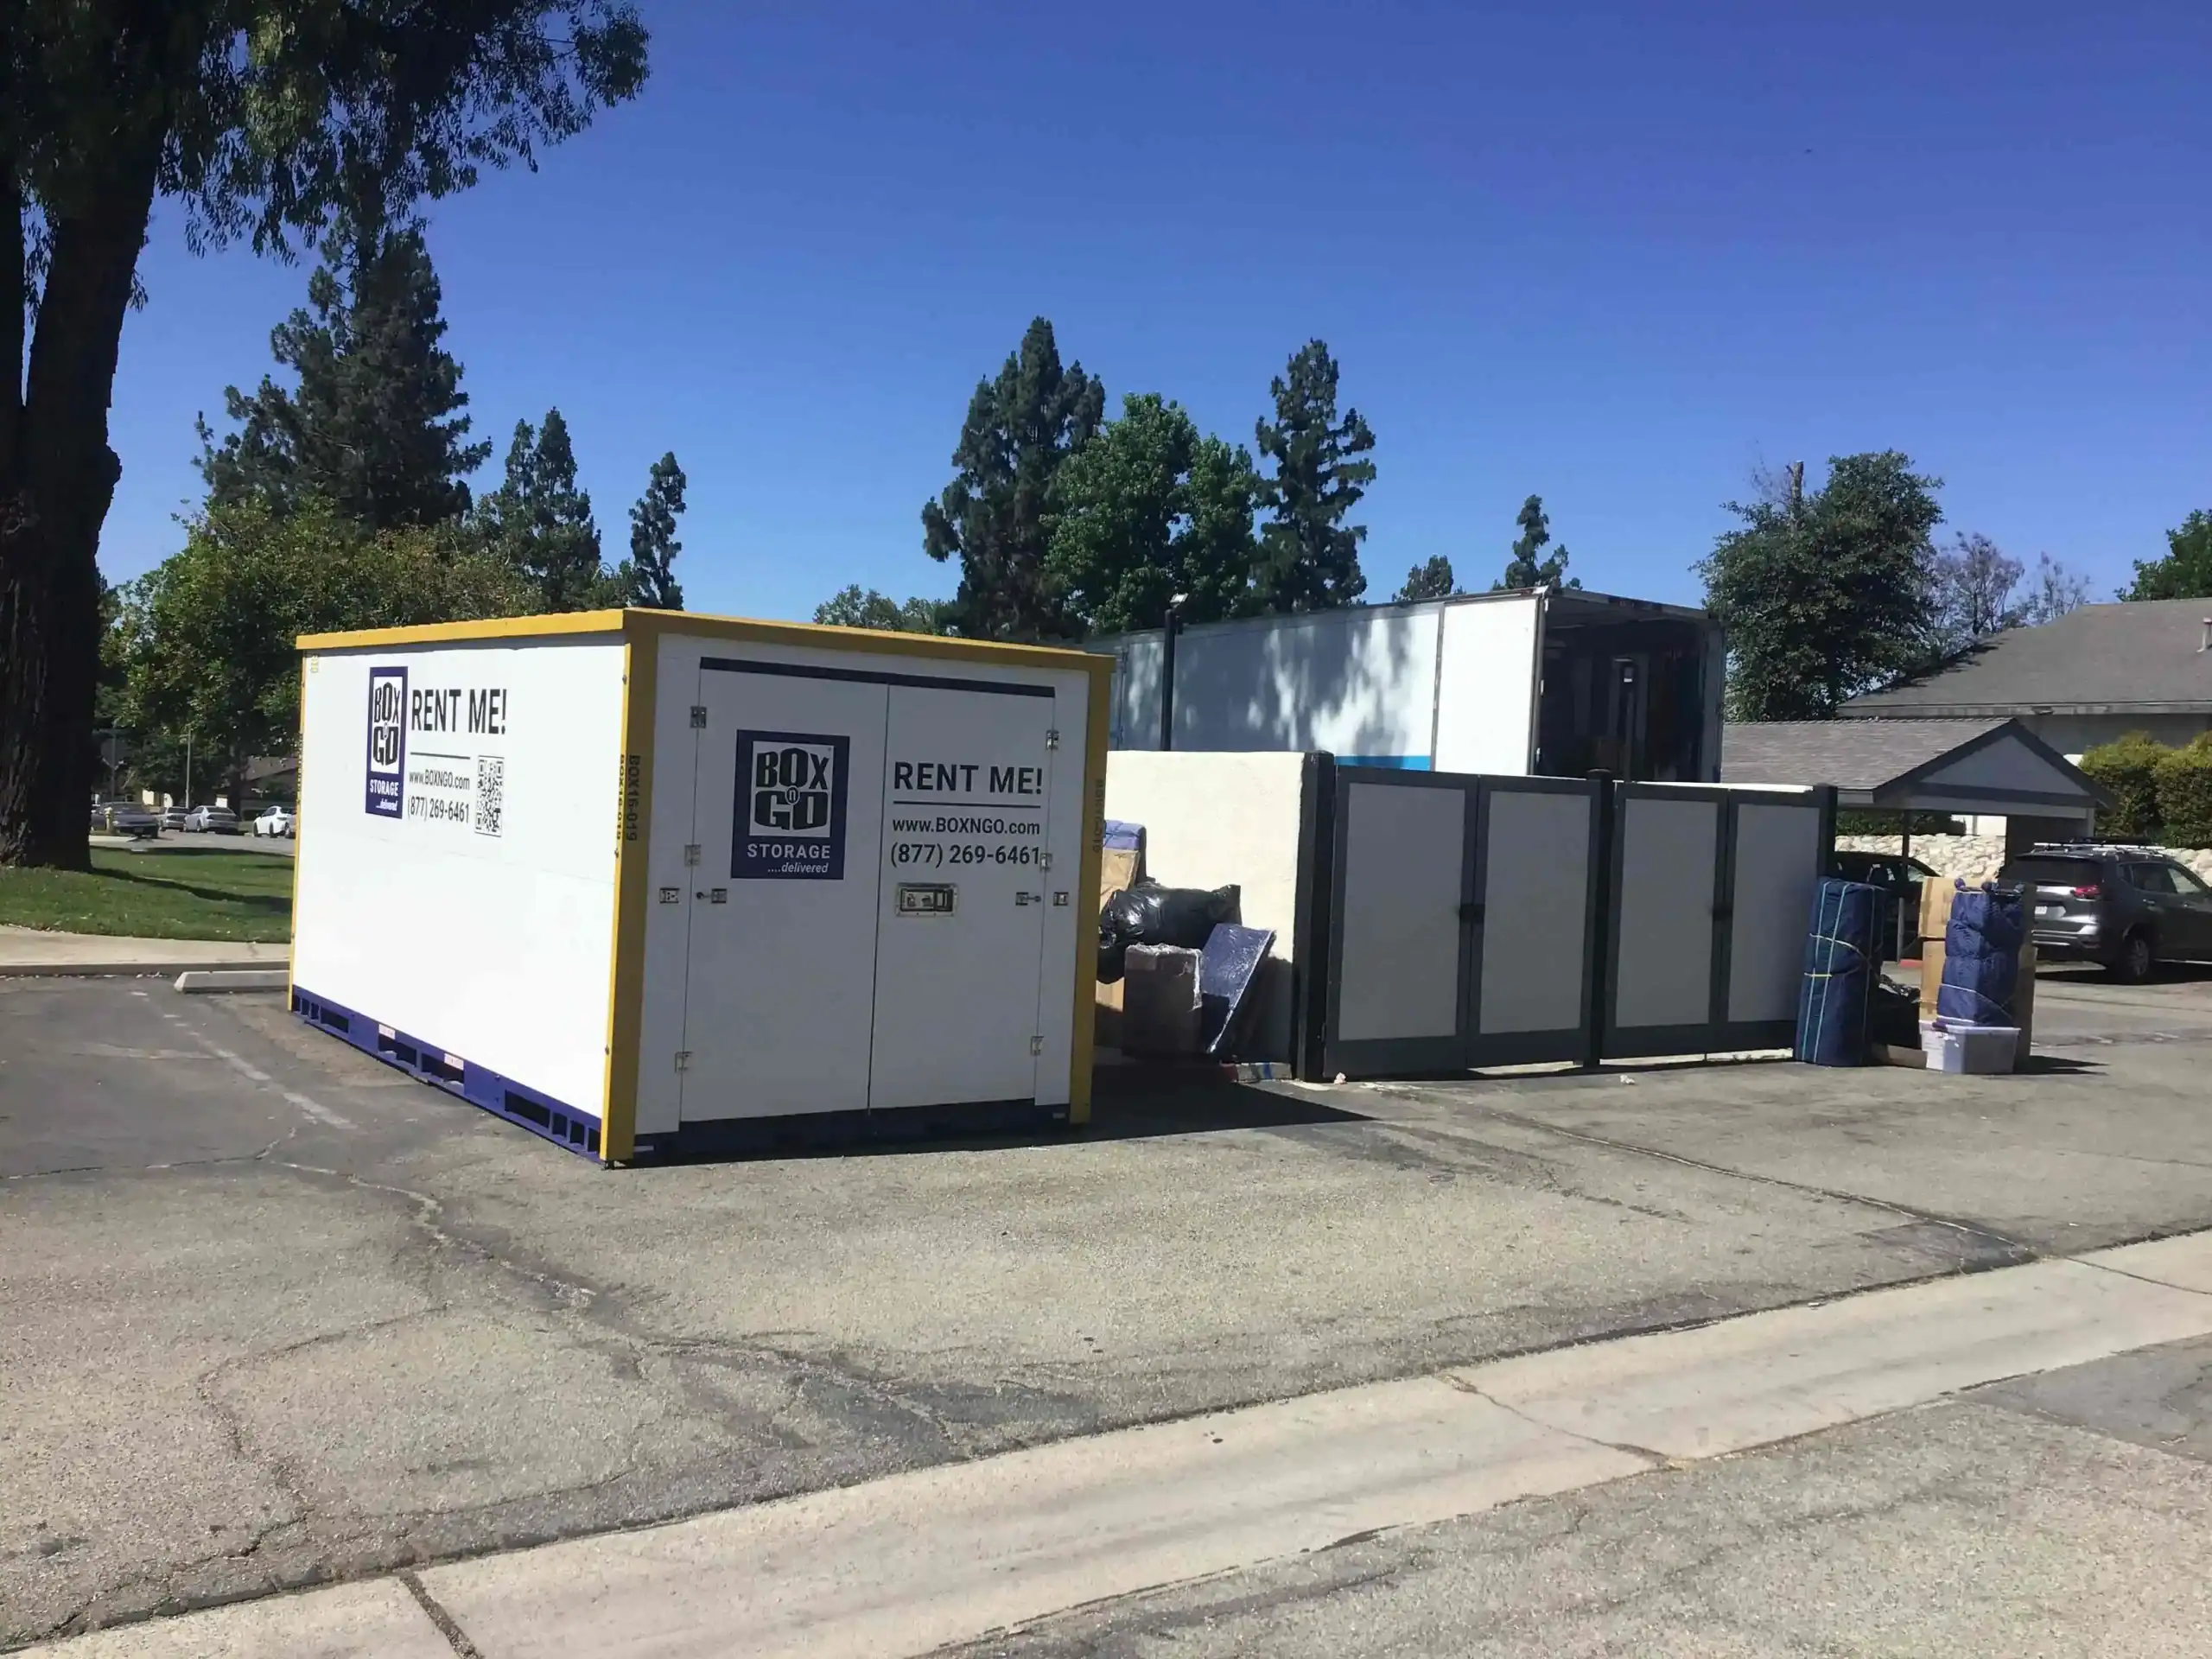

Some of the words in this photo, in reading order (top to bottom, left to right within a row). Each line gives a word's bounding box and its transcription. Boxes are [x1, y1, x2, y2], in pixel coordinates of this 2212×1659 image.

[373, 681, 400, 723] BOX
[411, 689, 461, 733] RENT
[468, 689, 507, 734] ME!
[372, 726, 399, 766] GO
[408, 769, 470, 790] www.BOXNGO.com
[755, 747, 830, 790] BOX
[893, 761, 979, 792] RENT
[989, 766, 1042, 795] ME!
[369, 779, 399, 797] STORAGE
[407, 796, 428, 821] (877)
[429, 798, 470, 823] 269-6461
[754, 790, 828, 830] GO
[892, 817, 1040, 835] www.BOXNGO.com
[747, 843, 831, 859] STORAGE
[891, 842, 944, 868] (877)
[949, 844, 1039, 865] 269-6461
